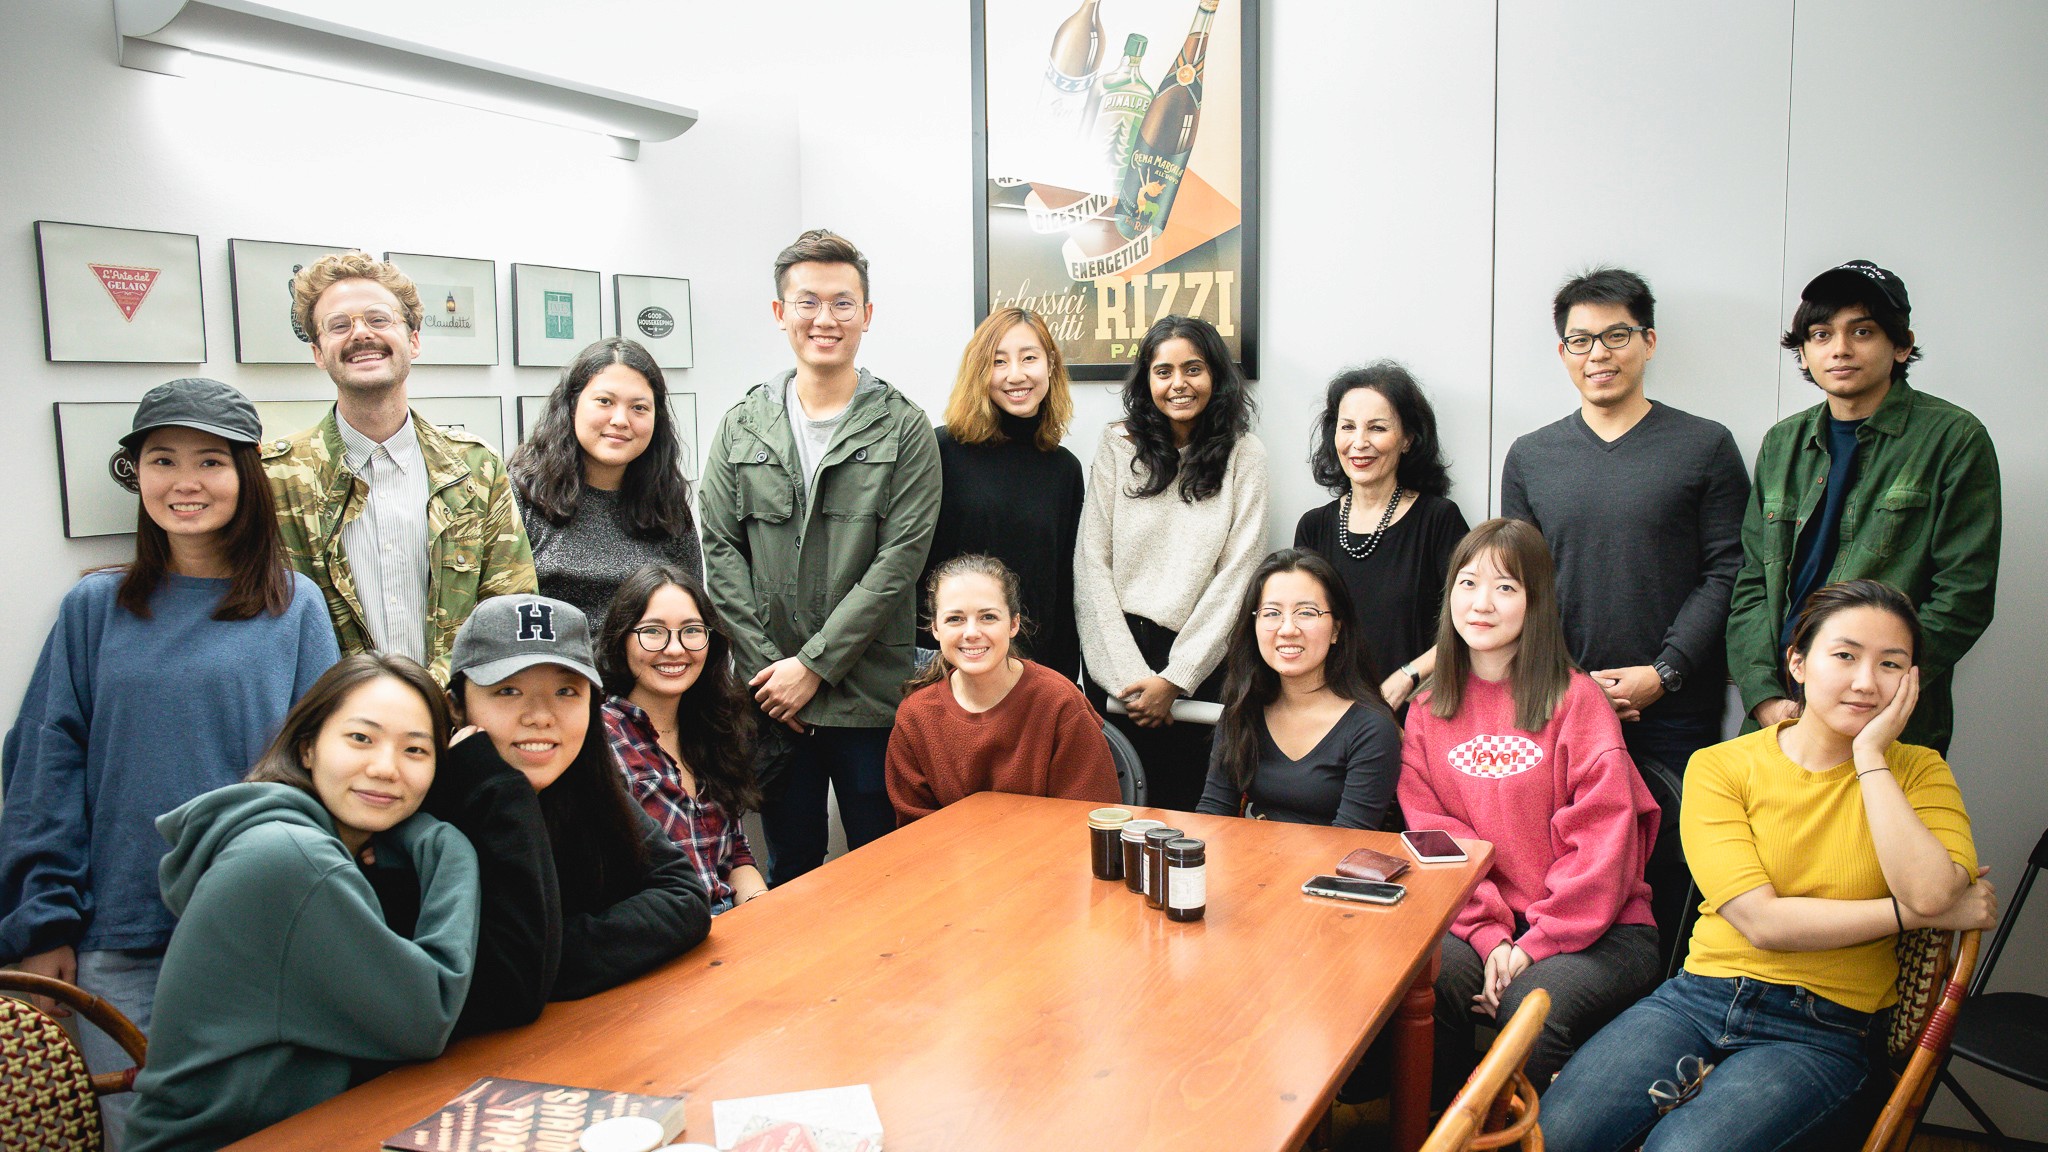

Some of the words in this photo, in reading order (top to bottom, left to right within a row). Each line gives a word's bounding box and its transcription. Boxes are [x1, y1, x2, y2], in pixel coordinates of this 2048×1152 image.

[1105, 95, 1149, 112] PINALPE
[1072, 235, 1149, 279] ENERGETICO
[102, 269, 133, 281] L'Arte
[133, 271, 150, 282] del
[107, 280, 147, 292] GELATO
[1004, 278, 1087, 315] classici
[1094, 270, 1235, 340] RIZZI
[424, 315, 472, 329] Claudette
[638, 318, 674, 327] HOUSEKEEPING
[515, 602, 556, 642] H
